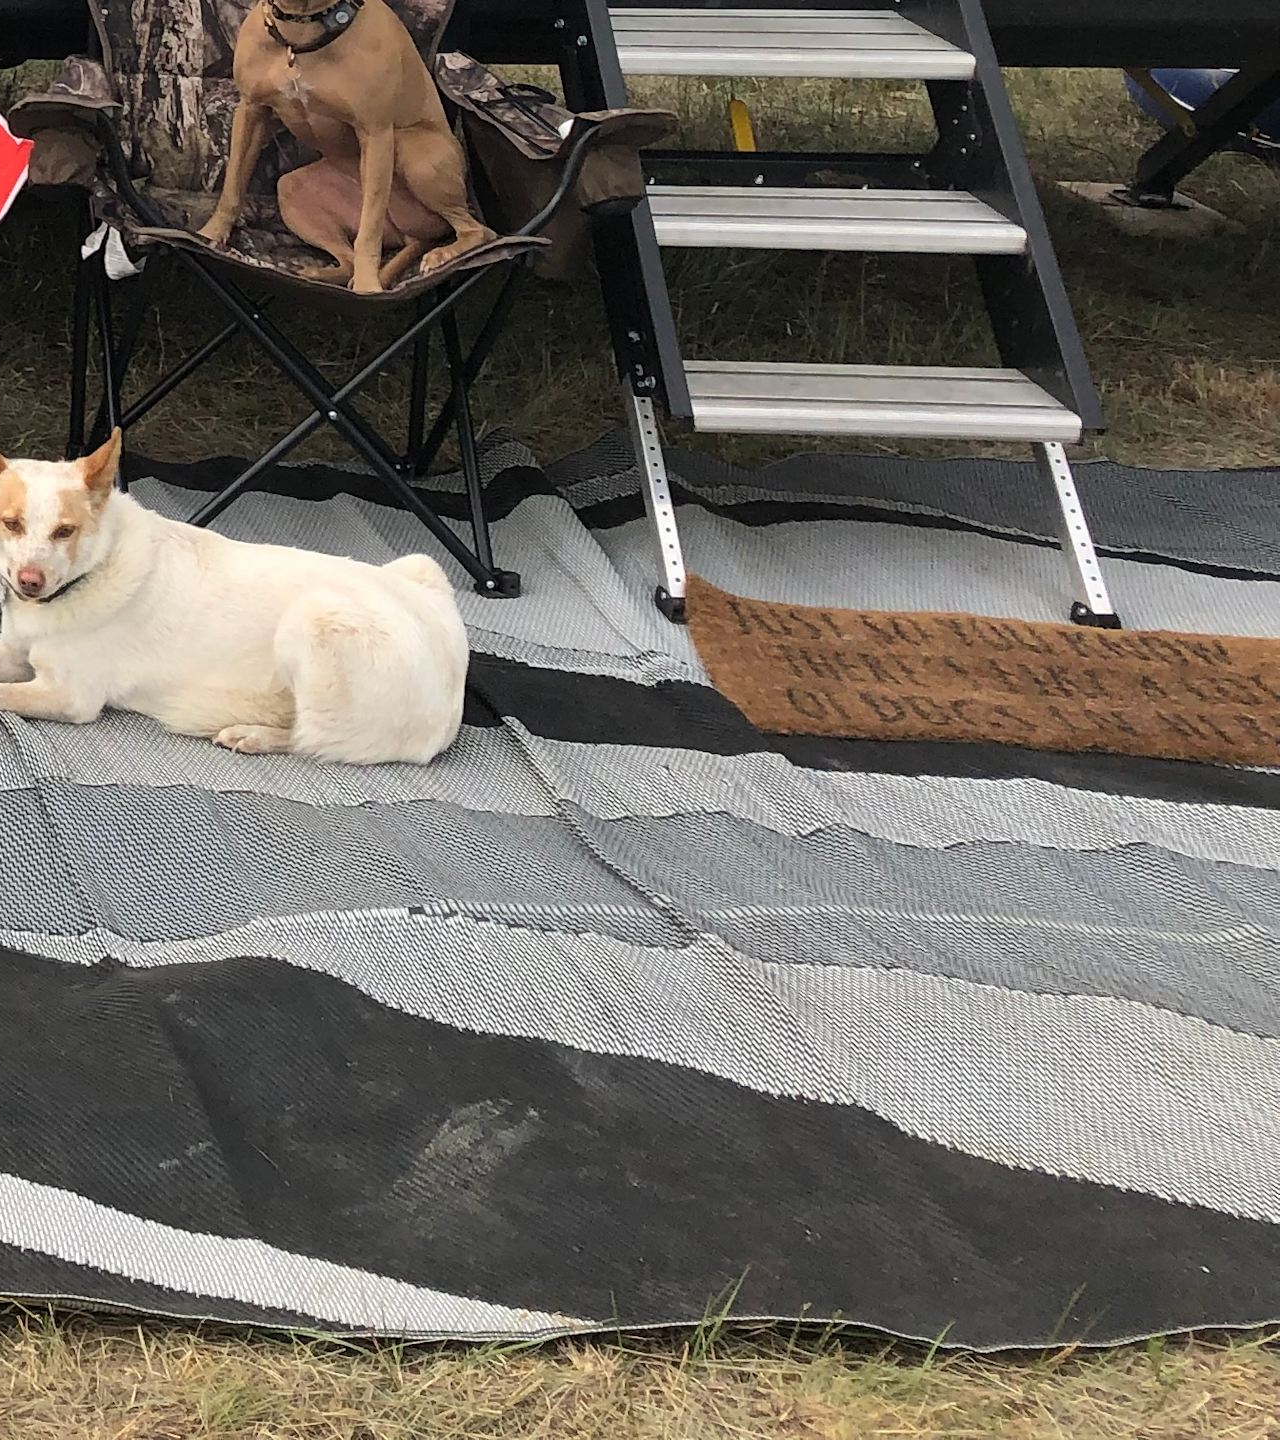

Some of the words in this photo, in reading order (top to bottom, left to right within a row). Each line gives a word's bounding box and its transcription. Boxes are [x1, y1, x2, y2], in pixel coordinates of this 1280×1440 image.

[726, 601, 842, 641] JUST
[934, 618, 1059, 657] YOU
[1056, 630, 1233, 667] KNOW
